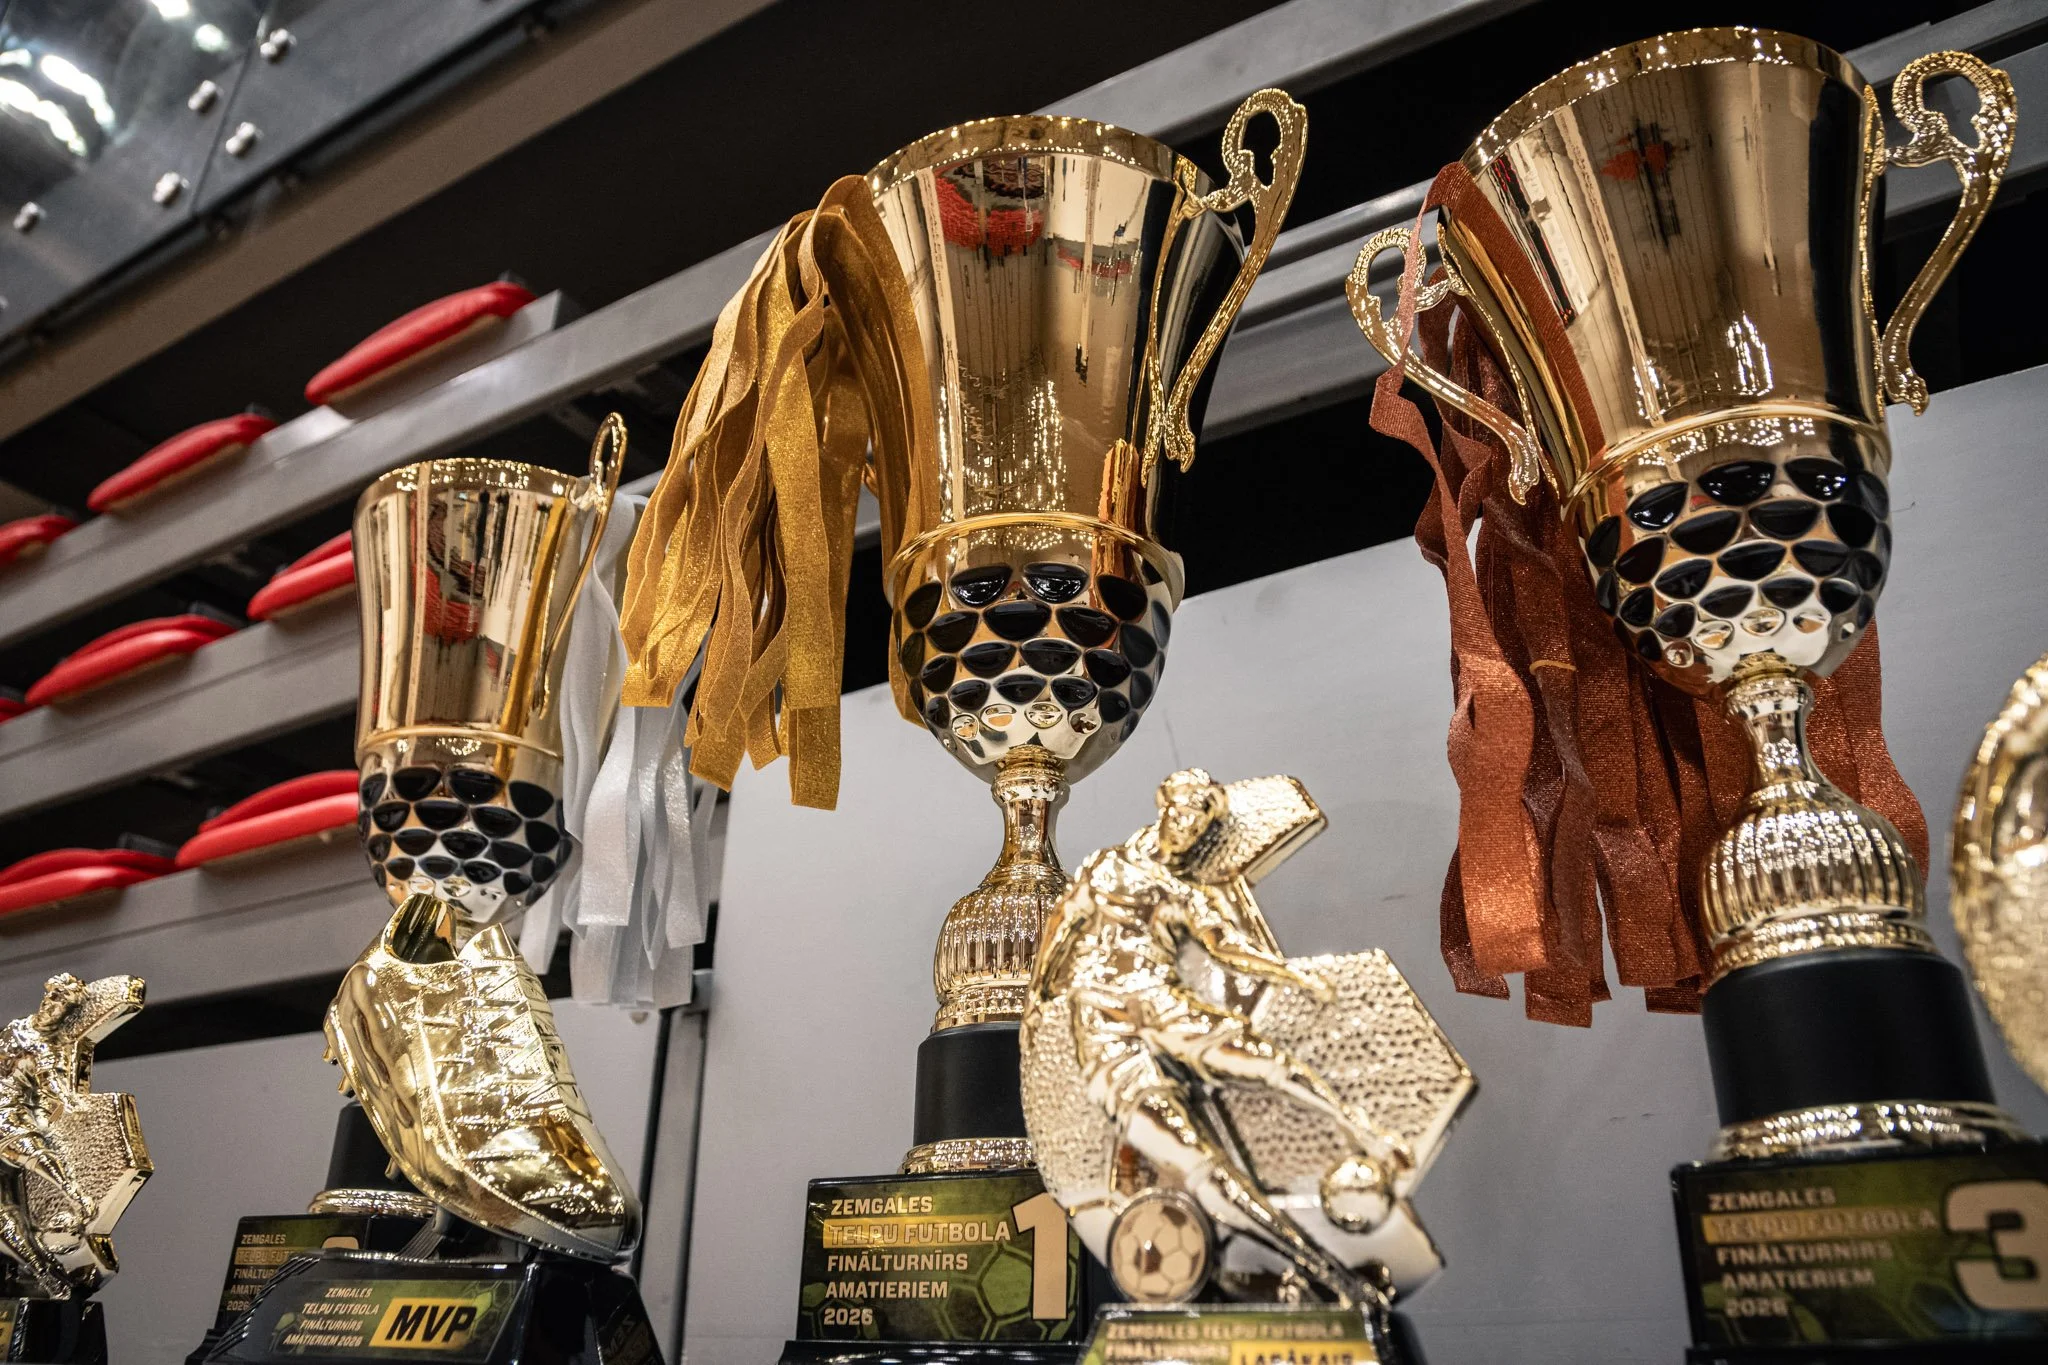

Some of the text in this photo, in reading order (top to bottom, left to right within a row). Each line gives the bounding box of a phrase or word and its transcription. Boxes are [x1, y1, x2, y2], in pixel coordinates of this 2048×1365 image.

[831, 1196, 933, 1215] ZEMGALES
[241, 1234, 287, 1244] ZEMGALES
[828, 1221, 1011, 1245] TELPU FUTBOLA
[1946, 1181, 2048, 1311] 3
[827, 1249, 968, 1272] FINĀLTURNĪRS
[1012, 1192, 1068, 1320] 1
[325, 1288, 373, 1298] ZEMGALES
[825, 1281, 948, 1299] AMATIERIEM
[302, 1303, 380, 1315] TELPU FUTBOLA
[823, 1308, 873, 1325] 2026
[385, 1305, 477, 1343] MVP
[283, 1334, 340, 1346] AMATIERIEM
